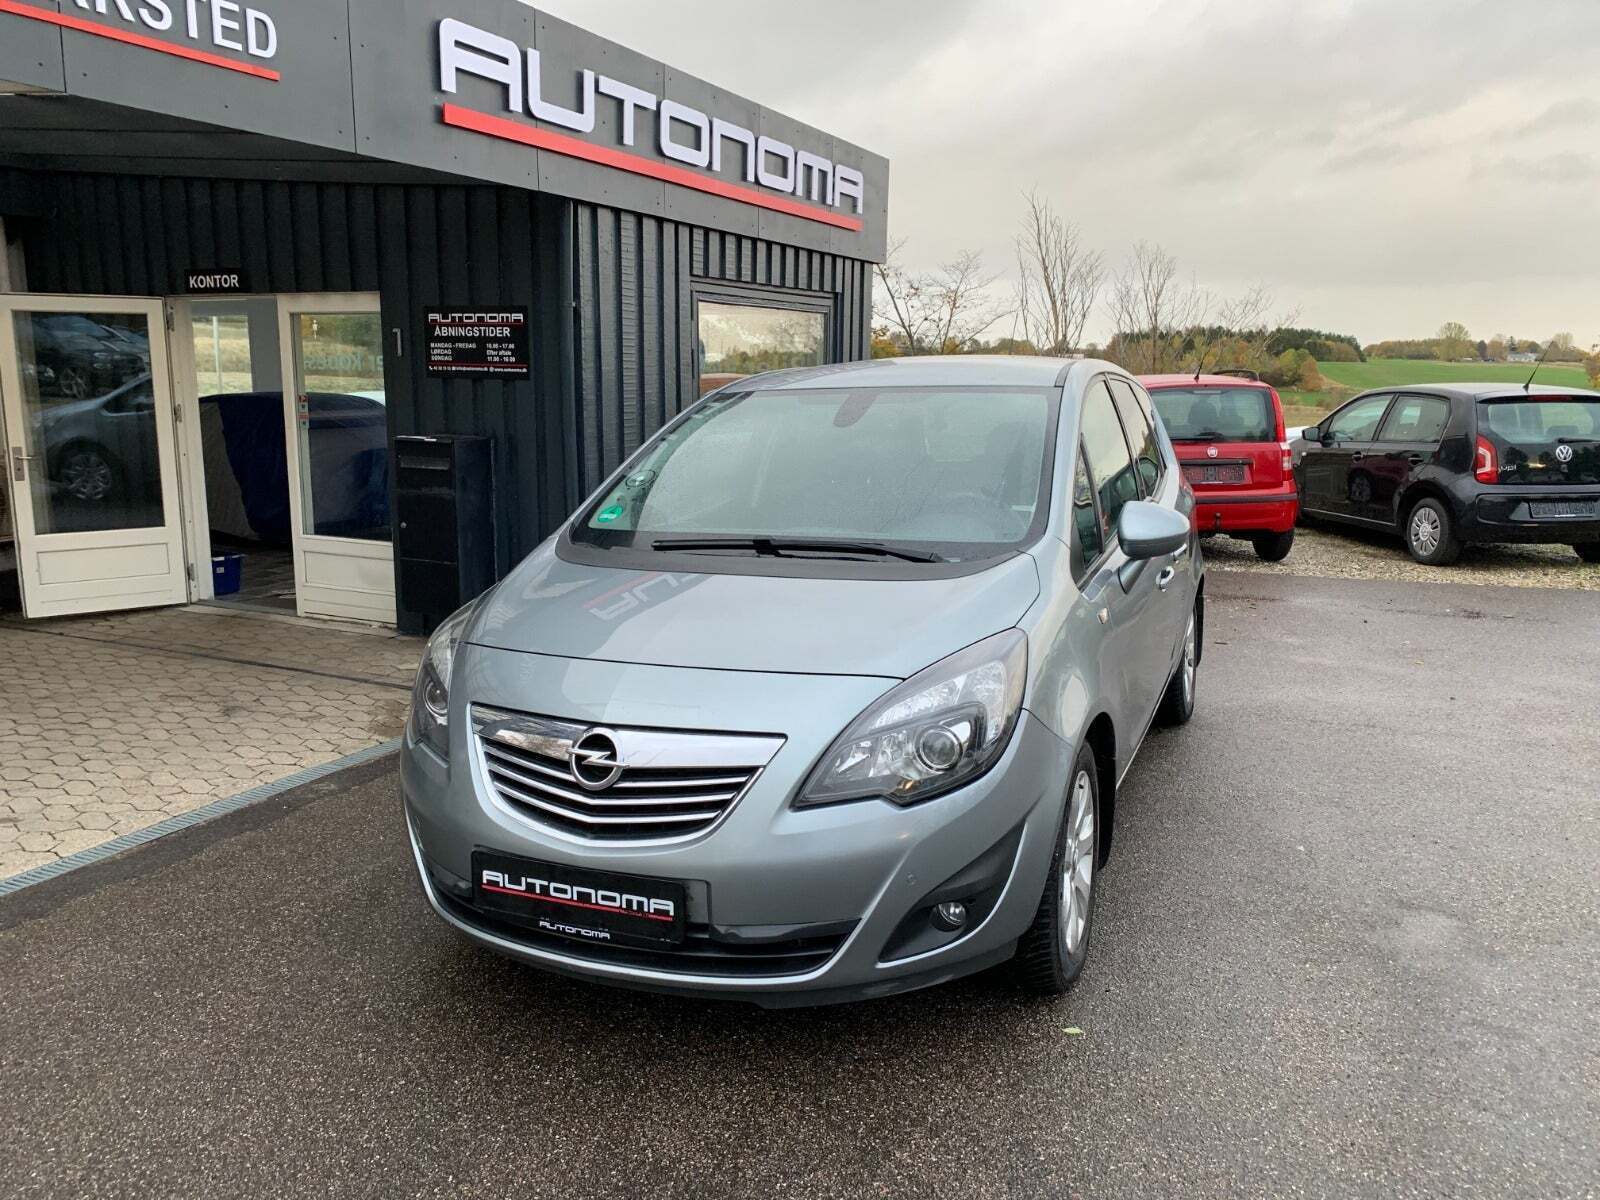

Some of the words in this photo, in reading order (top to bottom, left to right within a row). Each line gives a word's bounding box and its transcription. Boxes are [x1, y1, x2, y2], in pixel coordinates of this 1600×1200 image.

[75, 0, 278, 58] STED
[438, 17, 865, 215] AUTONOMA
[189, 274, 240, 289] KONTOR
[428, 313, 524, 323] AUTONOMA
[434, 325, 511, 337] ÅBNINGSTIDER
[482, 869, 675, 917] AUTONOMA
[539, 920, 611, 940] AUTONOMA
